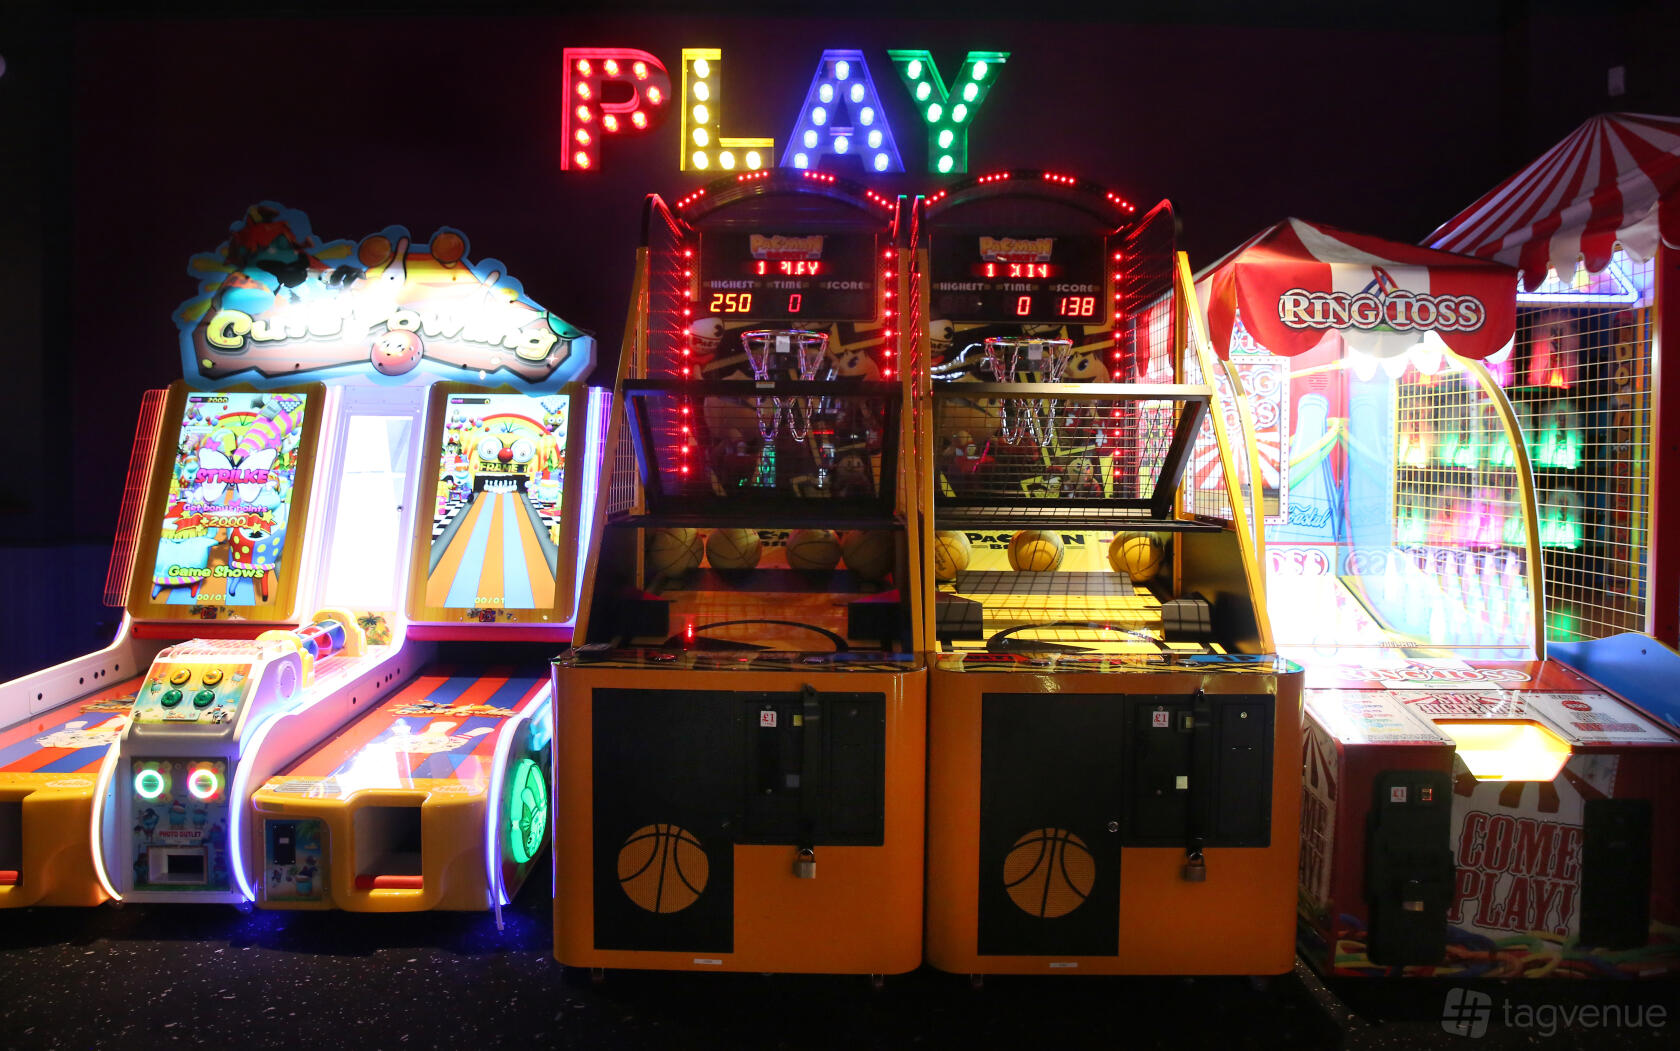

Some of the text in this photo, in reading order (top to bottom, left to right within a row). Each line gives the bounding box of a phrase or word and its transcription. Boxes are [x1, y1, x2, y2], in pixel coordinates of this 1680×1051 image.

[560, 47, 1011, 173] PLAY
[709, 280, 864, 290] HIGHEST TIME SCORE
[939, 282, 1093, 292] HIGHEST TIME SCORE
[710, 293, 802, 313] 250 0
[1016, 296, 1095, 316] 0 138
[1279, 294, 1478, 326] RING TOSS
[479, 461, 522, 473] FRAME
[183, 503, 268, 513] Get bonus points
[200, 516, 248, 529] +2000
[168, 565, 265, 578] Game Shows
[762, 712, 775, 723] £1
[1153, 713, 1167, 723] £1
[1459, 811, 1583, 882] COME
[1450, 868, 1577, 937] PLAY!
